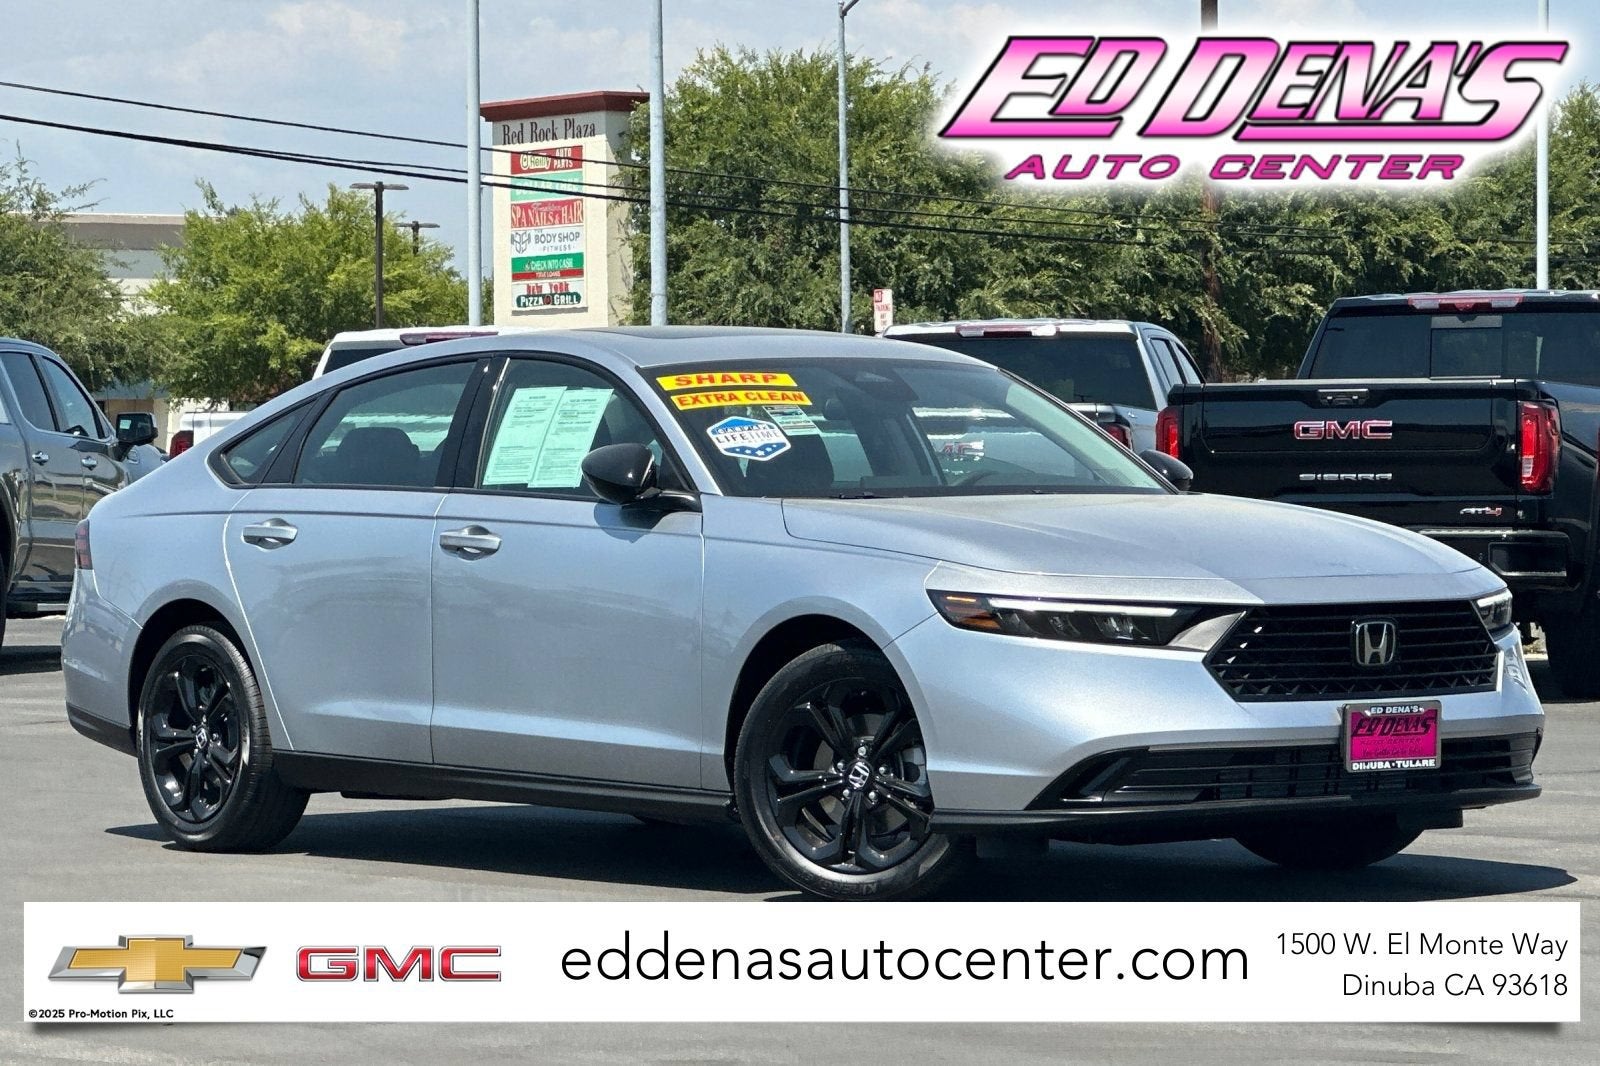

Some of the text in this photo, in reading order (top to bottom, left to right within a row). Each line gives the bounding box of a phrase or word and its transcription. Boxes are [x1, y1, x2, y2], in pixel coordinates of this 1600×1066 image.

[502, 117, 596, 146] Red Rock Plaza
[553, 159, 573, 169] PARTS
[511, 204, 527, 228] SPA
[528, 208, 554, 227] NAILS
[562, 200, 583, 225] HAIR
[534, 231, 580, 244] BODY SHOP
[520, 294, 579, 307] PIZZA GRILL
[675, 373, 778, 387] SHARP
[676, 391, 804, 406] EXTRA CLEAN
[715, 430, 780, 443] LIFETIME
[1293, 420, 1393, 440] GMC
[1299, 472, 1393, 481] SIERRA
[1386, 705, 1418, 714] DENA'S
[1396, 759, 1436, 769] TULARE
